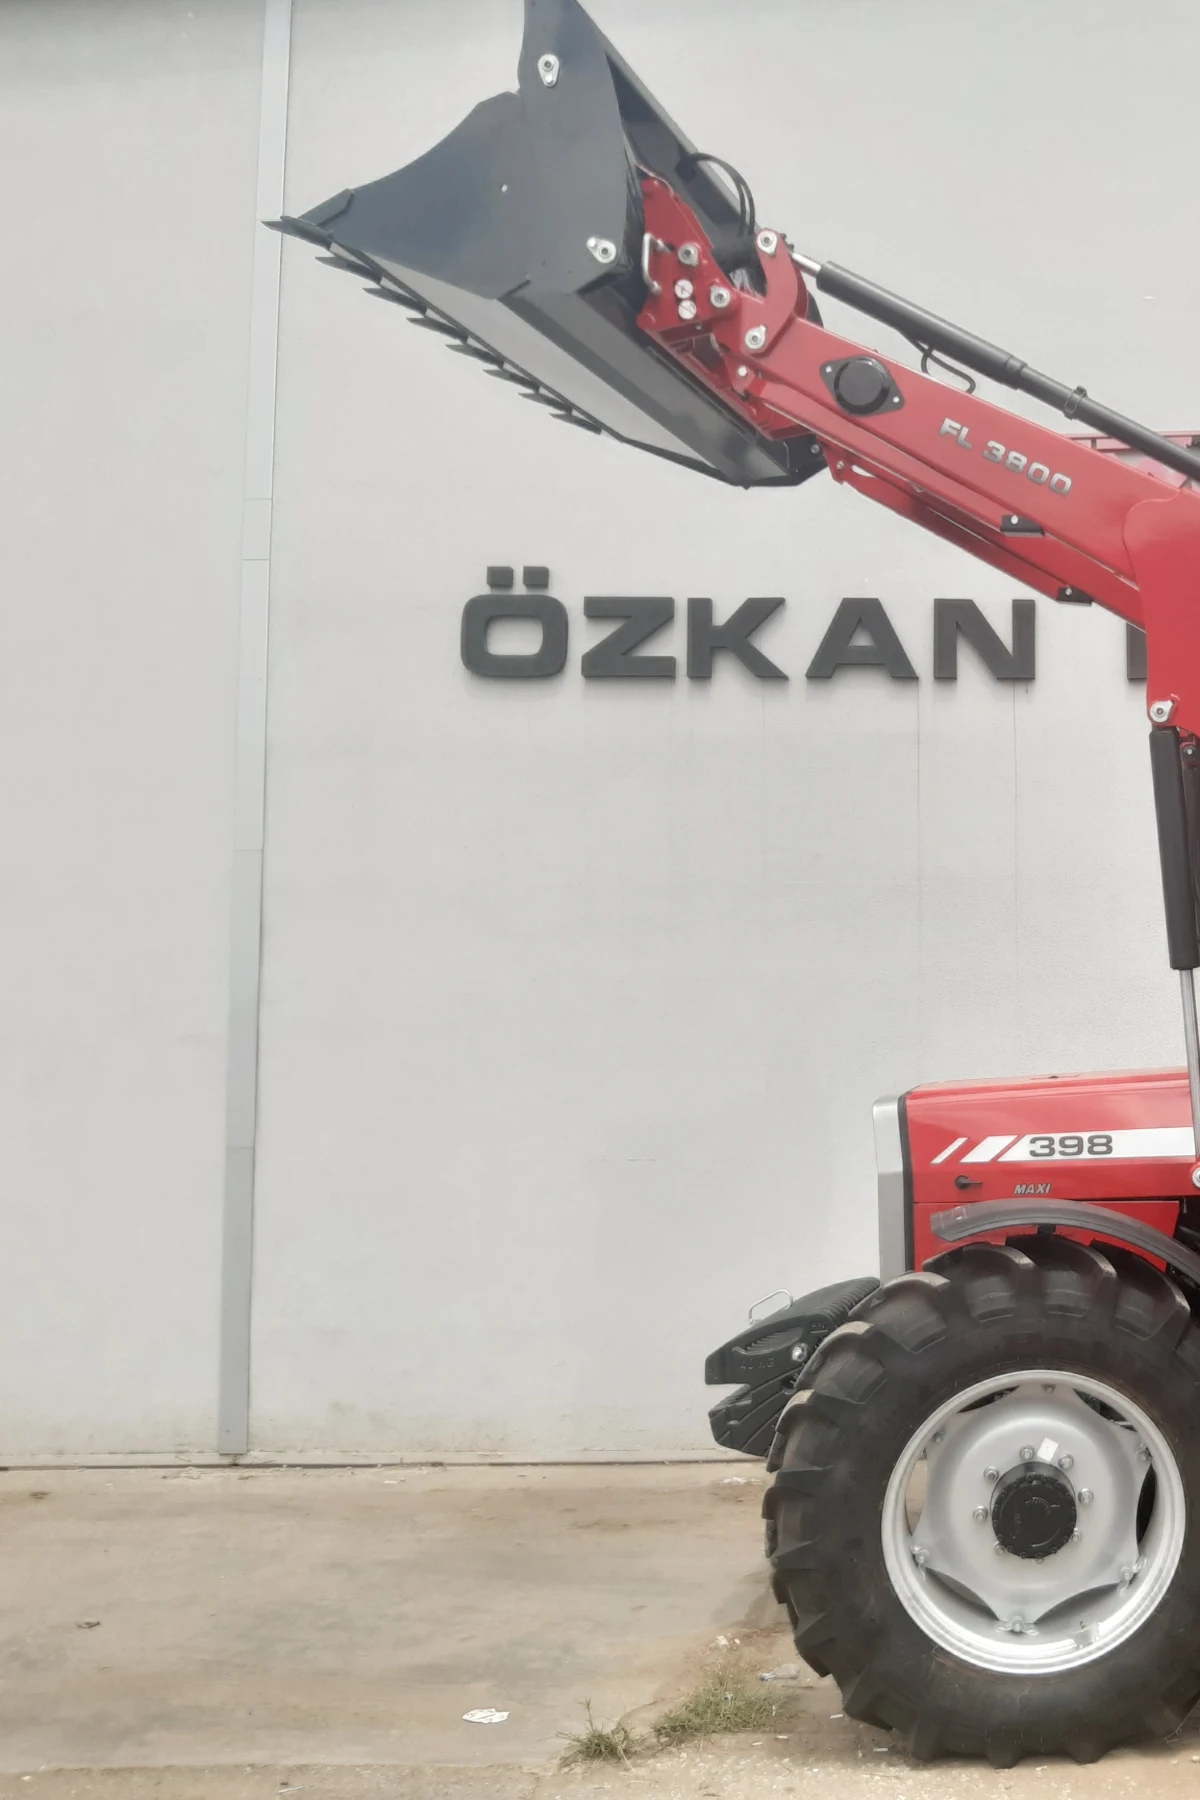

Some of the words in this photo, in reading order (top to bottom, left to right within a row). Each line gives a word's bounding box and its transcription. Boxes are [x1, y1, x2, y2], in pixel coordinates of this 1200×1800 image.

[939, 417, 974, 450] FL
[982, 440, 1073, 496] 3800
[460, 565, 1036, 681] ÖZKAN
[1029, 1134, 1114, 1157] 398
[1014, 1183, 1053, 1195] MAXI
